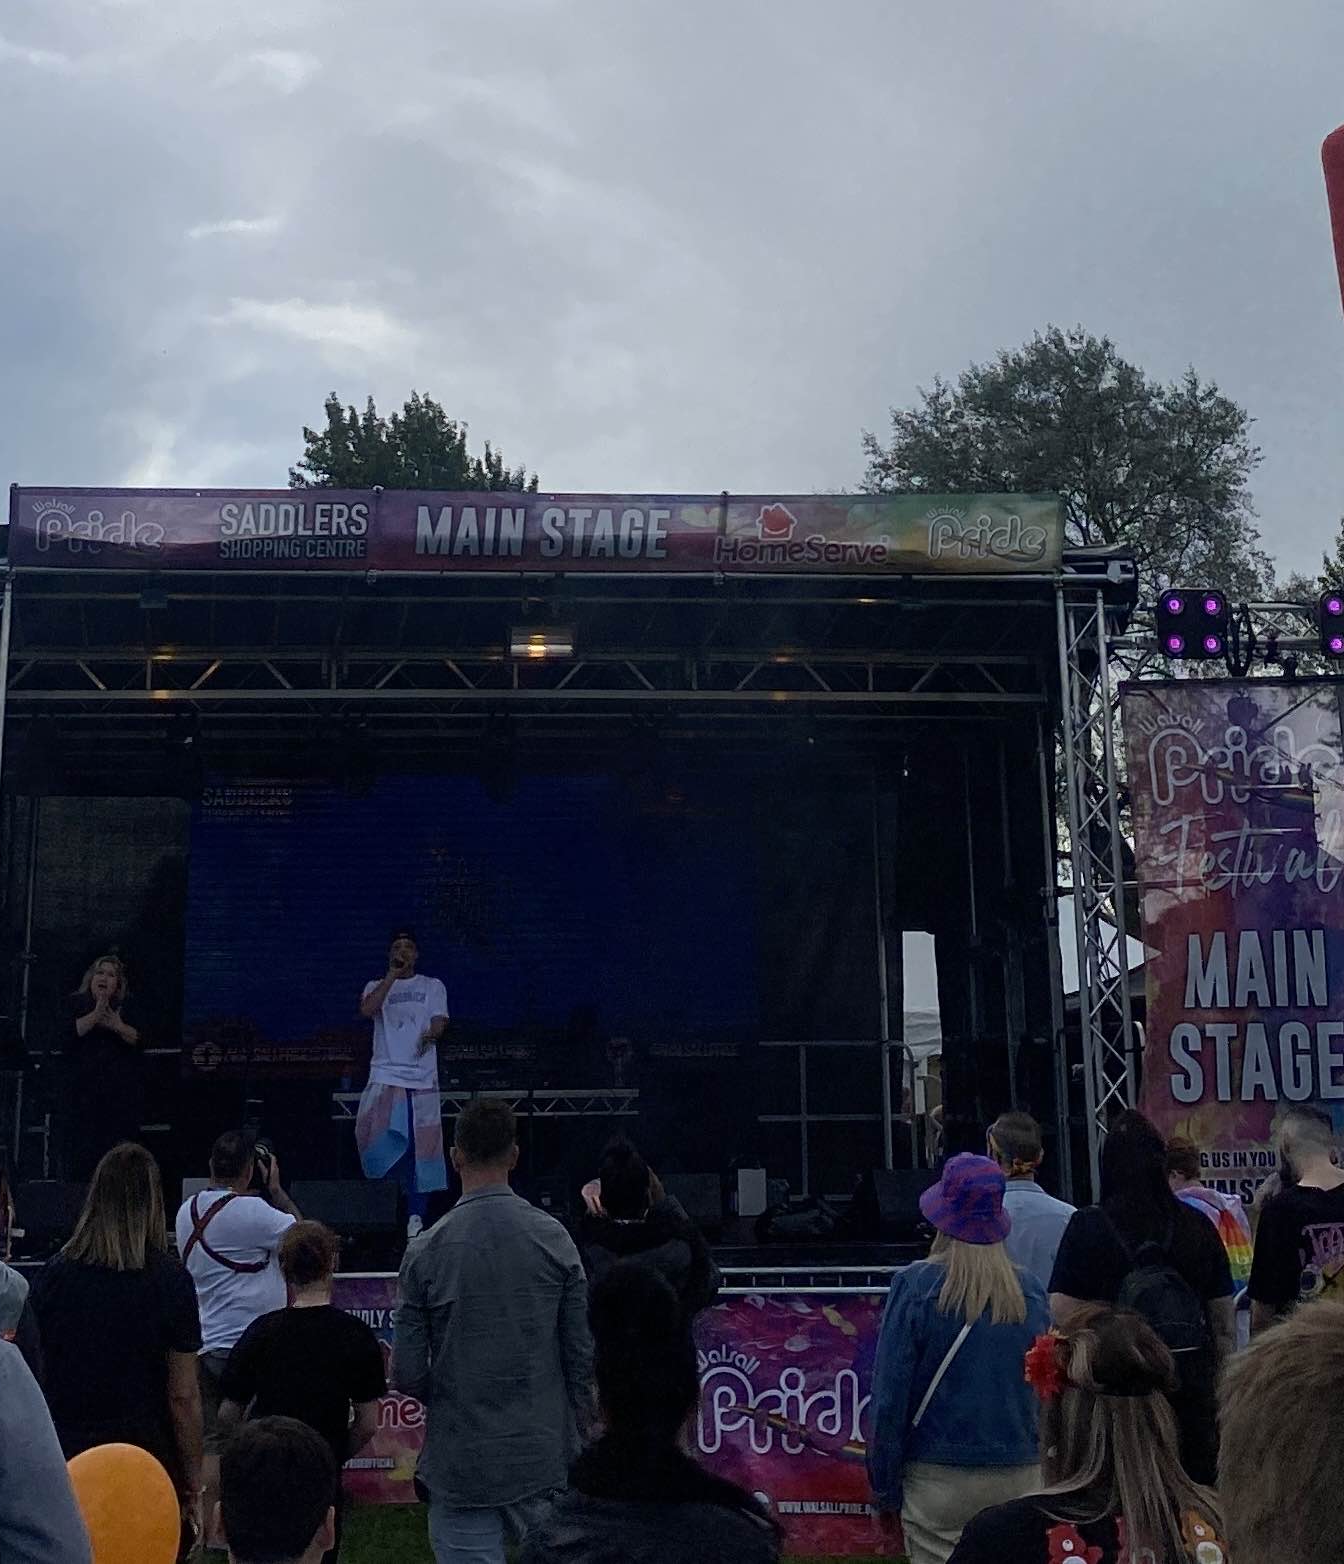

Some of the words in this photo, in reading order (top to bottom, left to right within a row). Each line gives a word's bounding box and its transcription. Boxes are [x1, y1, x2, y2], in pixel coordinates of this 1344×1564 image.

[32, 499, 77, 514] Walsall
[220, 503, 369, 536] SADDLERS
[35, 510, 165, 554] Pride
[219, 538, 301, 559] SHOPPING
[305, 538, 367, 558] CENTRE
[415, 506, 526, 556] MAIN
[540, 508, 671, 559] STAGE
[715, 526, 890, 565] HomeServe
[928, 514, 1048, 560] Pride
[1138, 714, 1206, 737] Walsall
[1148, 725, 1342, 806] Pride
[1152, 809, 1343, 900] Festival
[1184, 929, 1328, 1009] MAIN
[1212, 1152, 1230, 1168] US
[1233, 1152, 1247, 1167] IN
[1250, 1151, 1276, 1167] YOU
[697, 1367, 872, 1455] Prid
